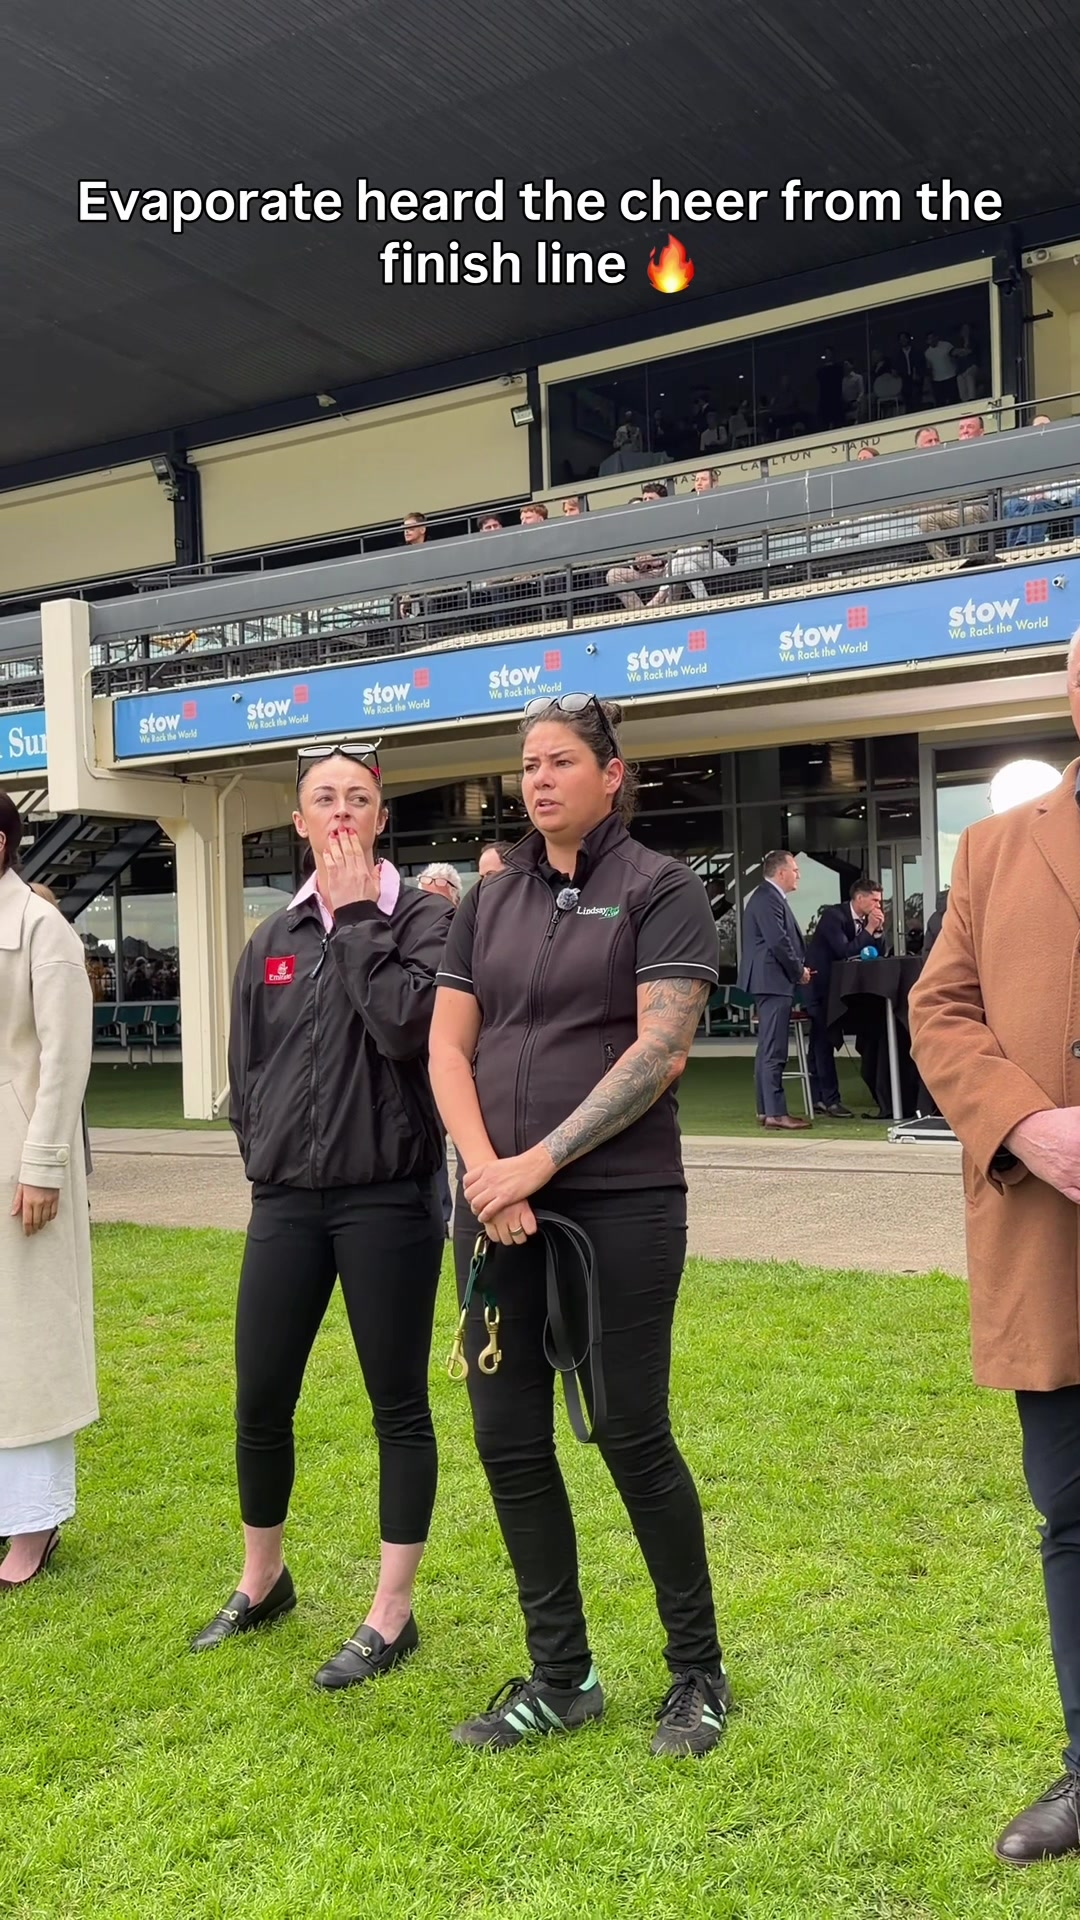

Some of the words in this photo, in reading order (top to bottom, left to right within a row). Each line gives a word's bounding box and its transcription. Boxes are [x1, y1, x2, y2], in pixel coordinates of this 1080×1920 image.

[740, 450, 812, 472] CALYON
[948, 597, 1021, 628] stow
[779, 622, 843, 651] stow
[948, 628, 966, 640] We
[969, 623, 995, 638] Rack
[996, 622, 1013, 634] the
[1015, 615, 1049, 631] World
[626, 645, 685, 672] stow
[778, 651, 795, 663] We
[797, 647, 820, 661] Rack
[821, 646, 837, 658] the
[838, 640, 869, 655] World
[488, 663, 542, 689] stow
[626, 672, 642, 683] We
[643, 668, 664, 681] Rack
[665, 667, 679, 678] the
[680, 662, 708, 676] World
[362, 681, 411, 706] stow
[488, 689, 503, 700] We
[504, 686, 523, 698] Rack
[523, 685, 536, 696] the
[537, 681, 562, 693] World
[247, 697, 292, 721] stow
[362, 705, 376, 715] We
[395, 702, 406, 712] the
[407, 698, 431, 710] World
[139, 712, 181, 735] stow
[247, 721, 259, 730] We
[288, 713, 309, 725] World
